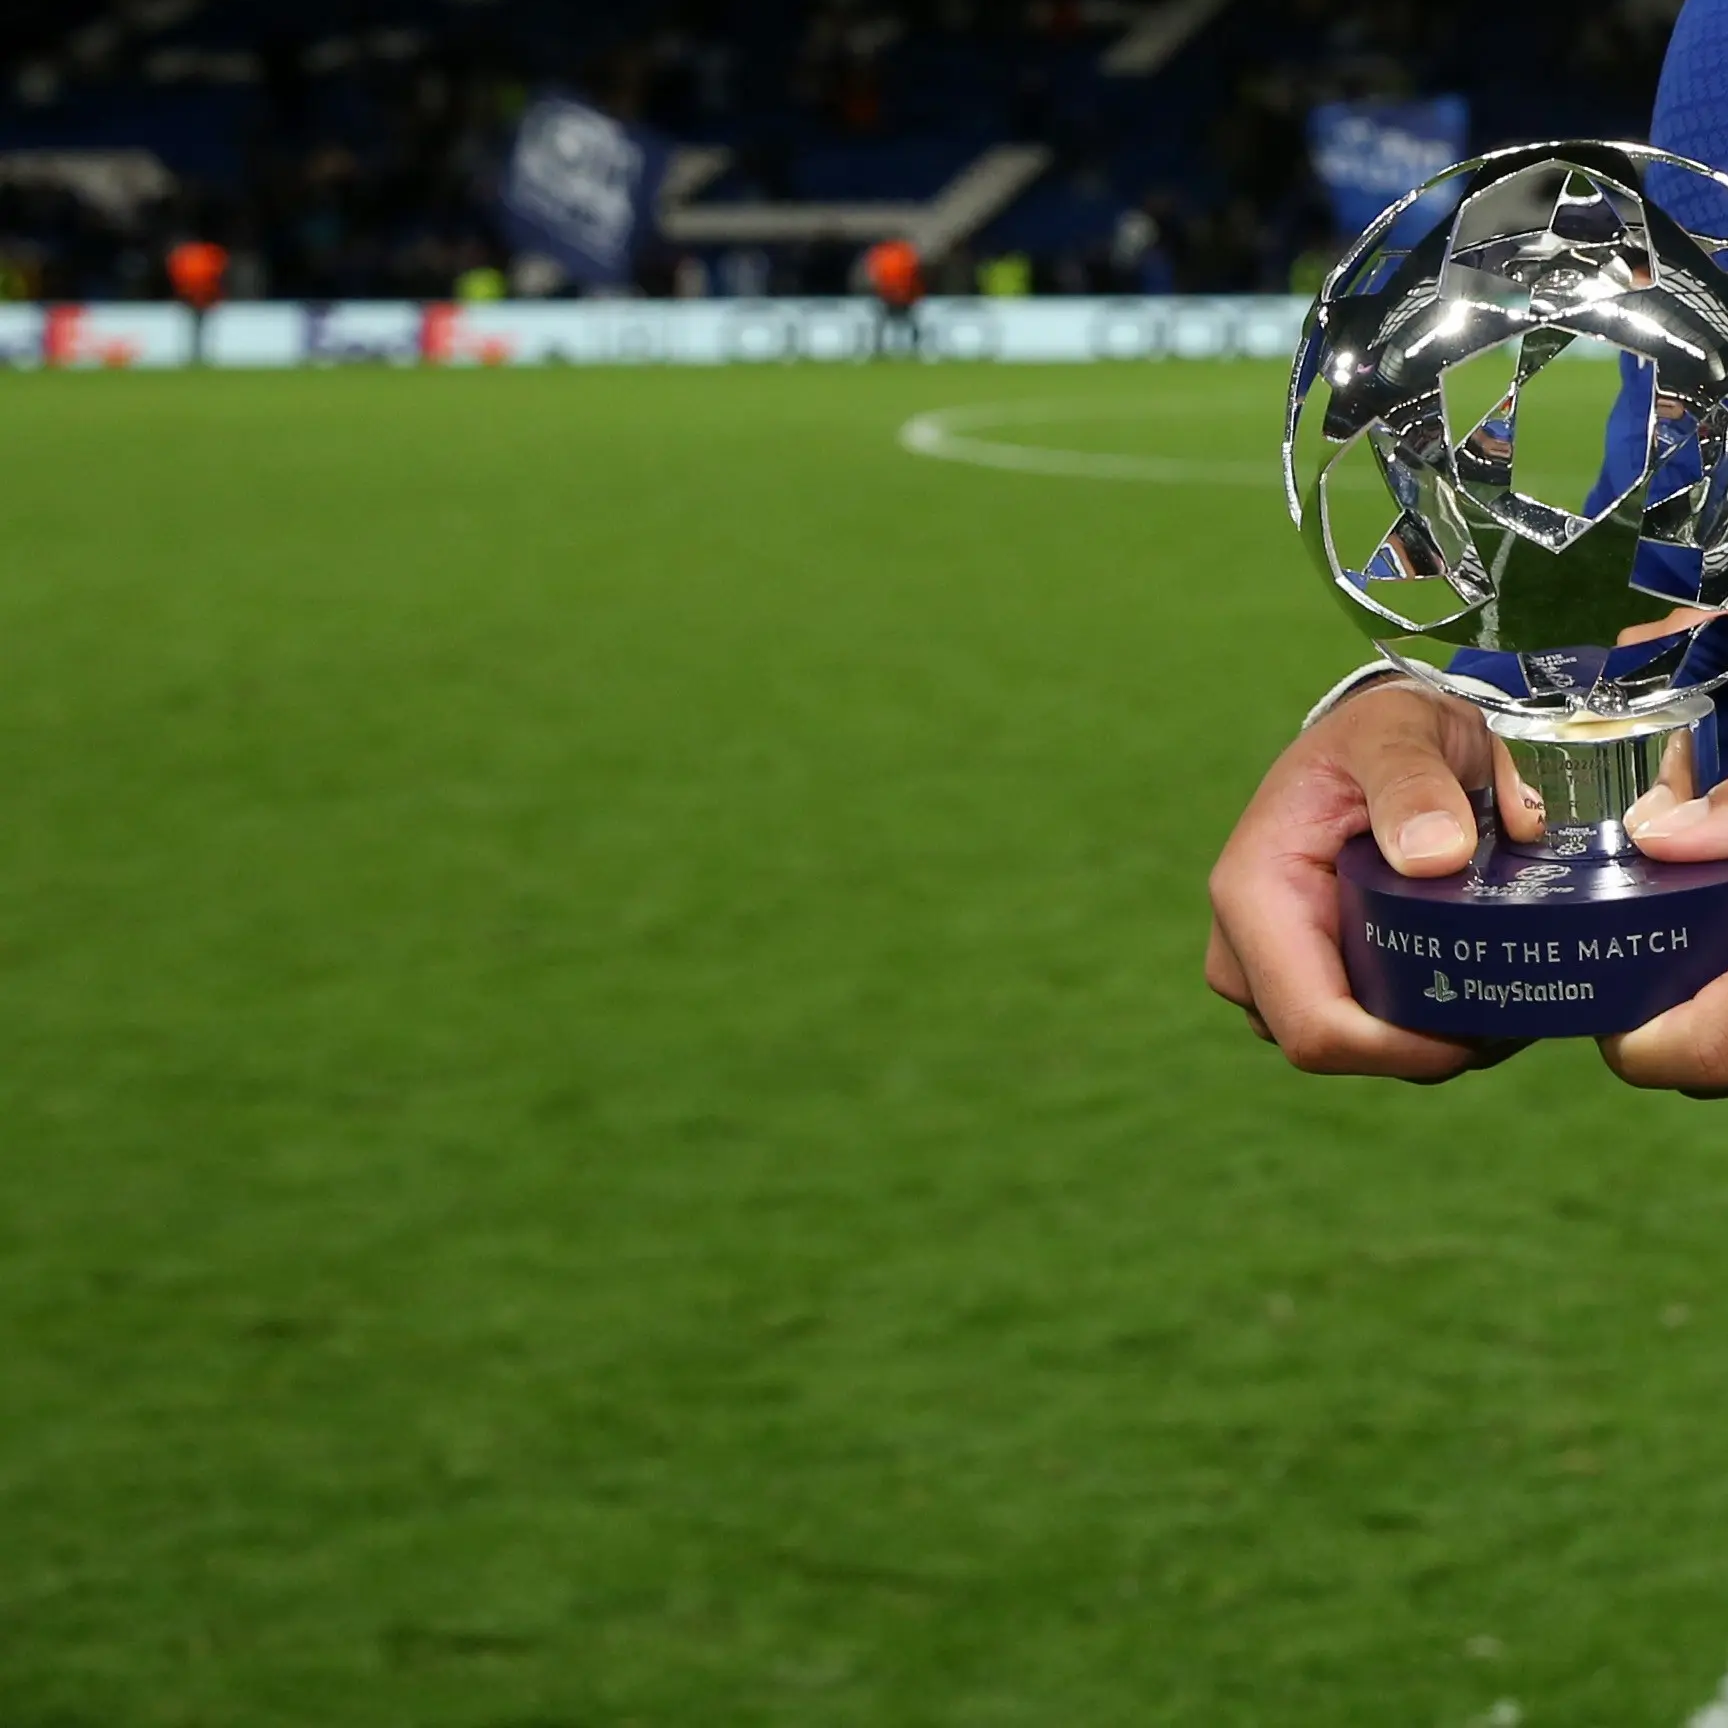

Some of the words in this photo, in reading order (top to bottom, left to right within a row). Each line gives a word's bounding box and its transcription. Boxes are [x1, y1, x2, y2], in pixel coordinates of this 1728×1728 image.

[1365, 922, 1442, 959] PLAYER
[1454, 940, 1487, 963] OF
[1501, 941, 1561, 964] THE
[1578, 927, 1689, 962] MATCH
[1463, 978, 1595, 1008] PlayStation
